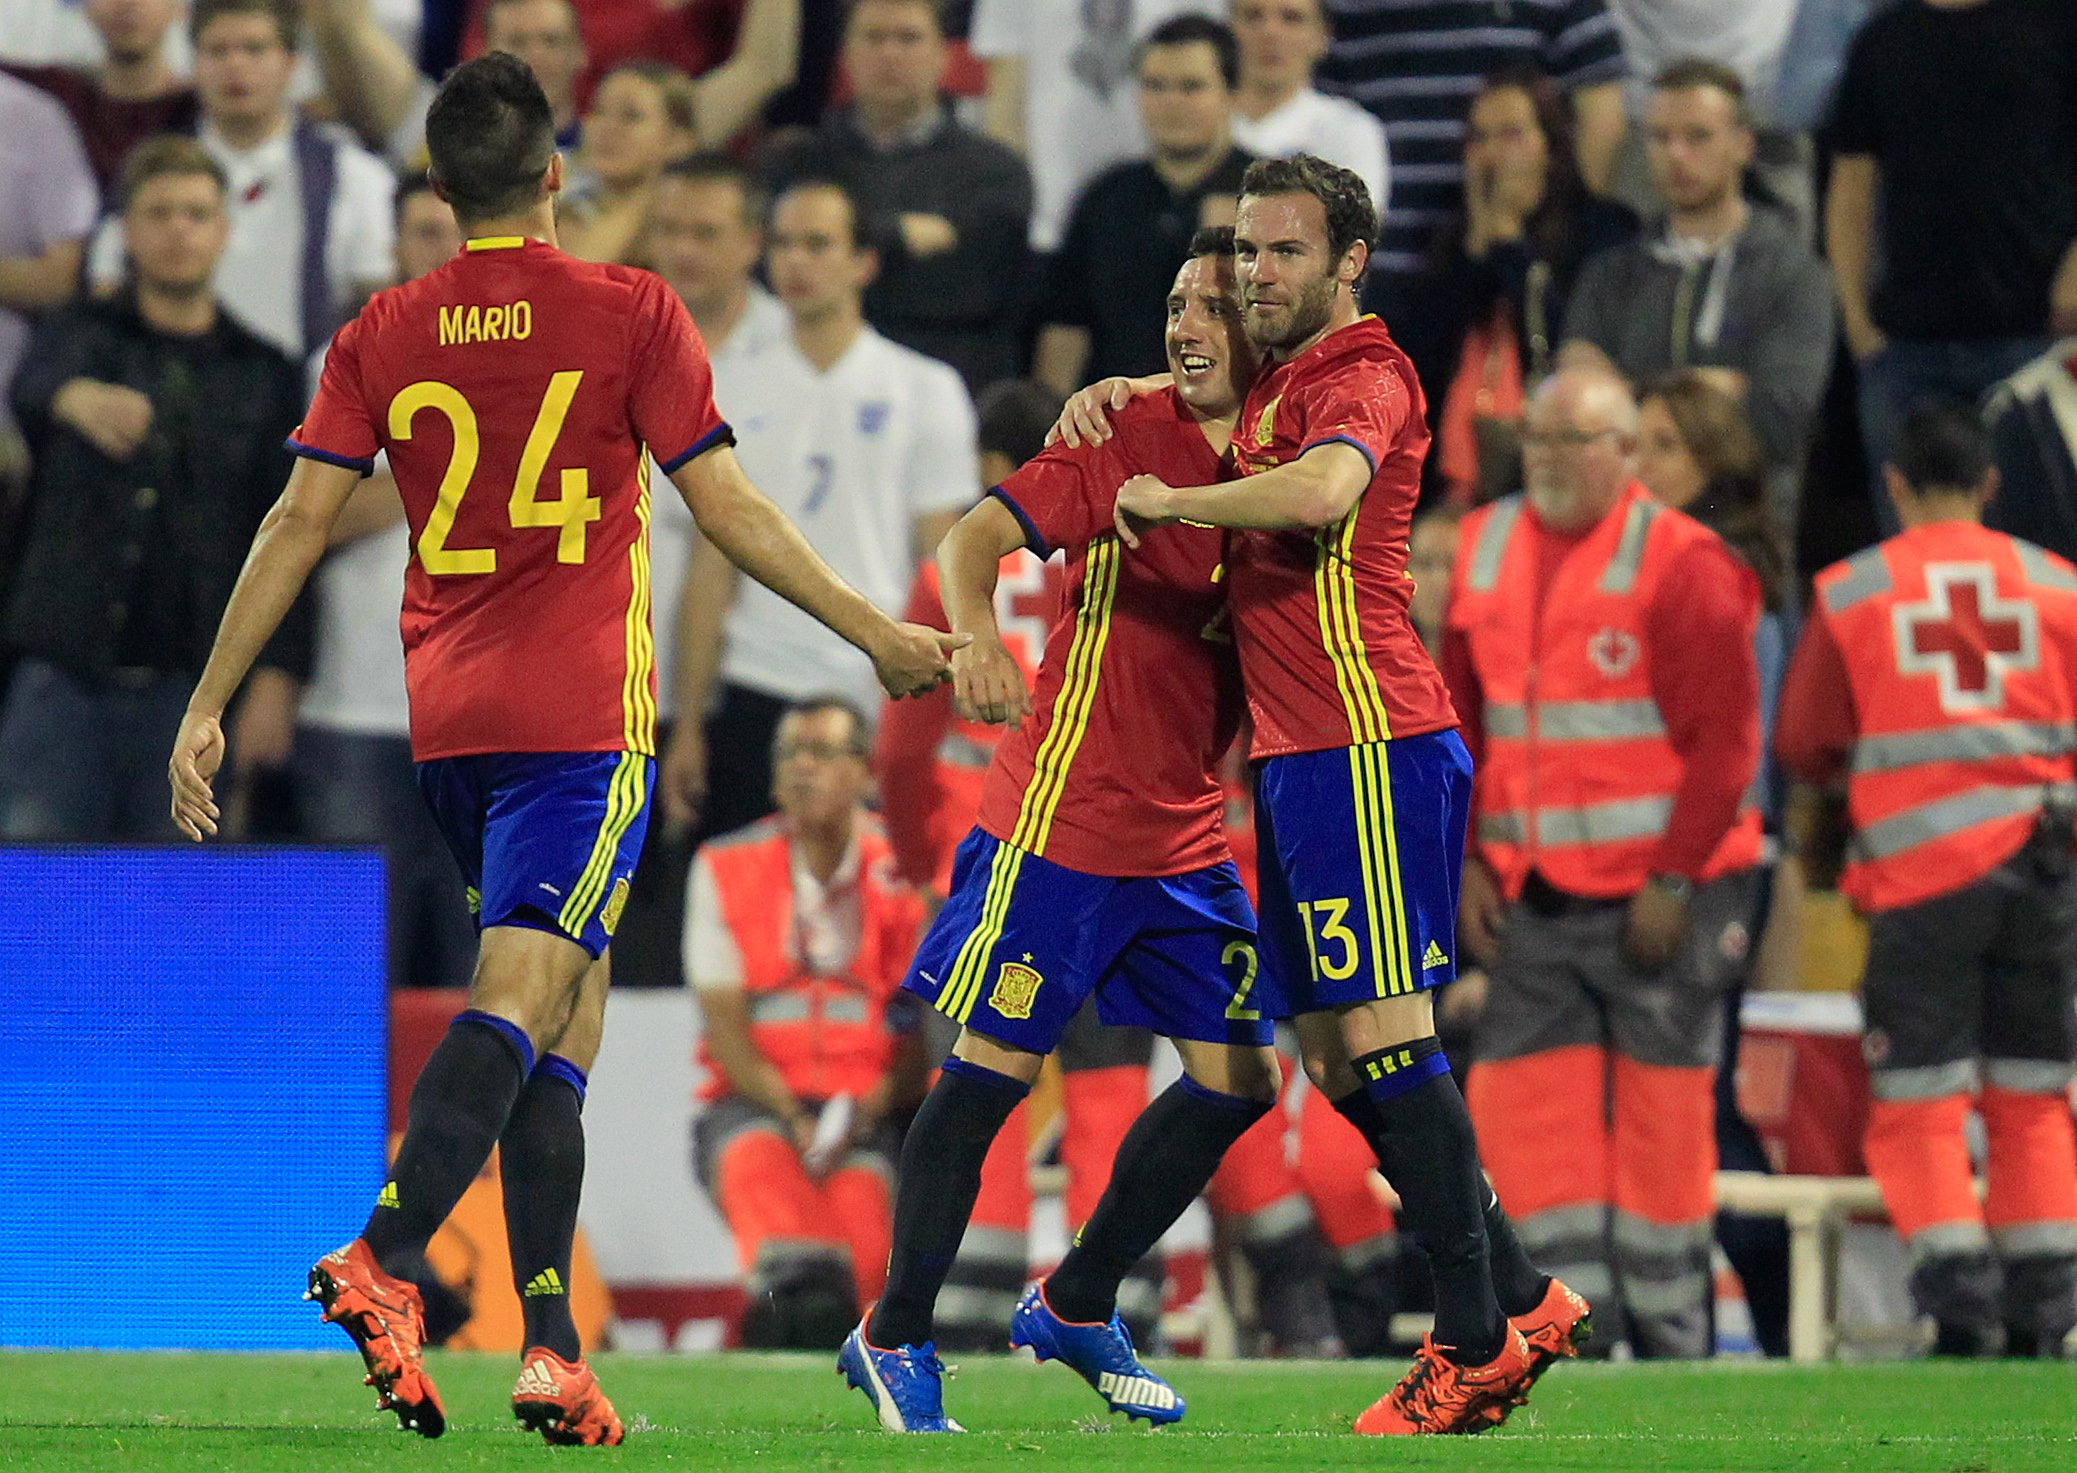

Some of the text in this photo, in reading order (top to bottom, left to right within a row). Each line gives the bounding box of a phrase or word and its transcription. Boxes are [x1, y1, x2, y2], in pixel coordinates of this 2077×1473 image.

[438, 300, 532, 345] MARIO
[387, 370, 601, 575] 24
[803, 454, 834, 513] 7
[1297, 897, 1360, 982] 13
[1098, 1371, 1175, 1410] PUMA
